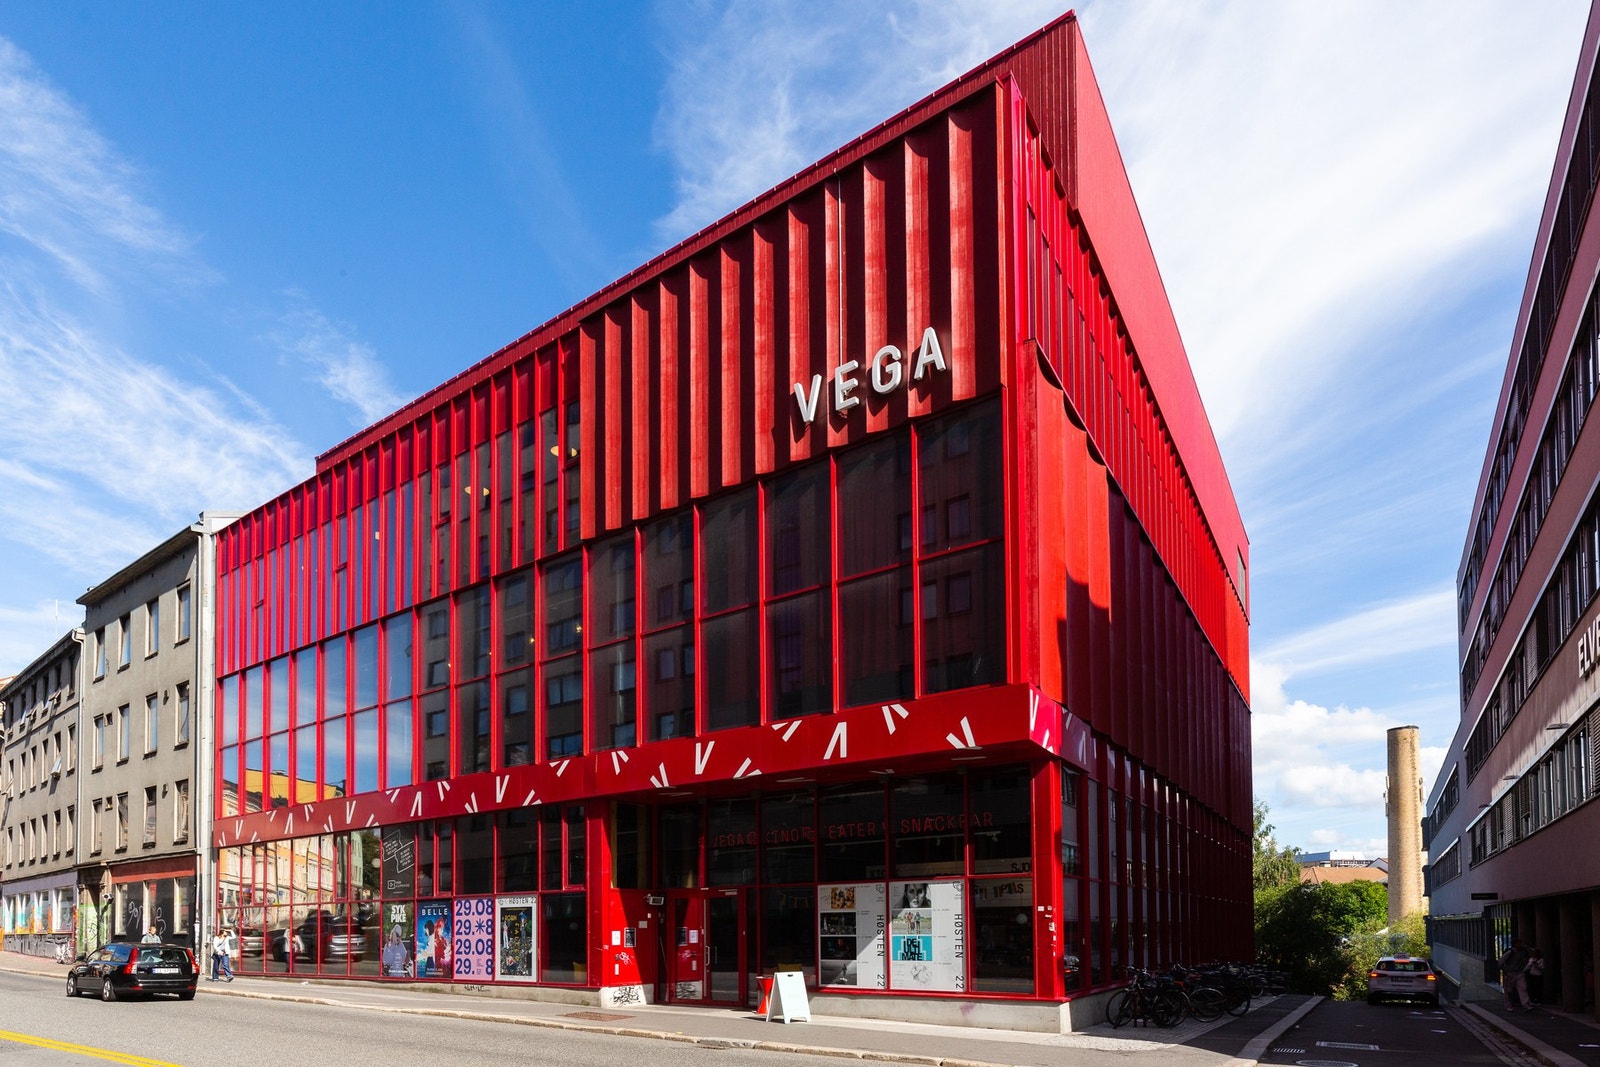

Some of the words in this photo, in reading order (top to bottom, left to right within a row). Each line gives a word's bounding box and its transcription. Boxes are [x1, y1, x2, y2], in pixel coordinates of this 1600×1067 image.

[794, 326, 946, 423] VEGA
[391, 904, 406, 914] SYK
[421, 908, 448, 916] BELLE
[456, 898, 493, 916] 29.08
[390, 913, 407, 923] PIKE
[876, 914, 885, 957] HØSTEN
[954, 913, 964, 958] HØSTEN
[456, 938, 493, 955] 29.08
[877, 974, 886, 987] 22
[955, 975, 965, 989] 22
